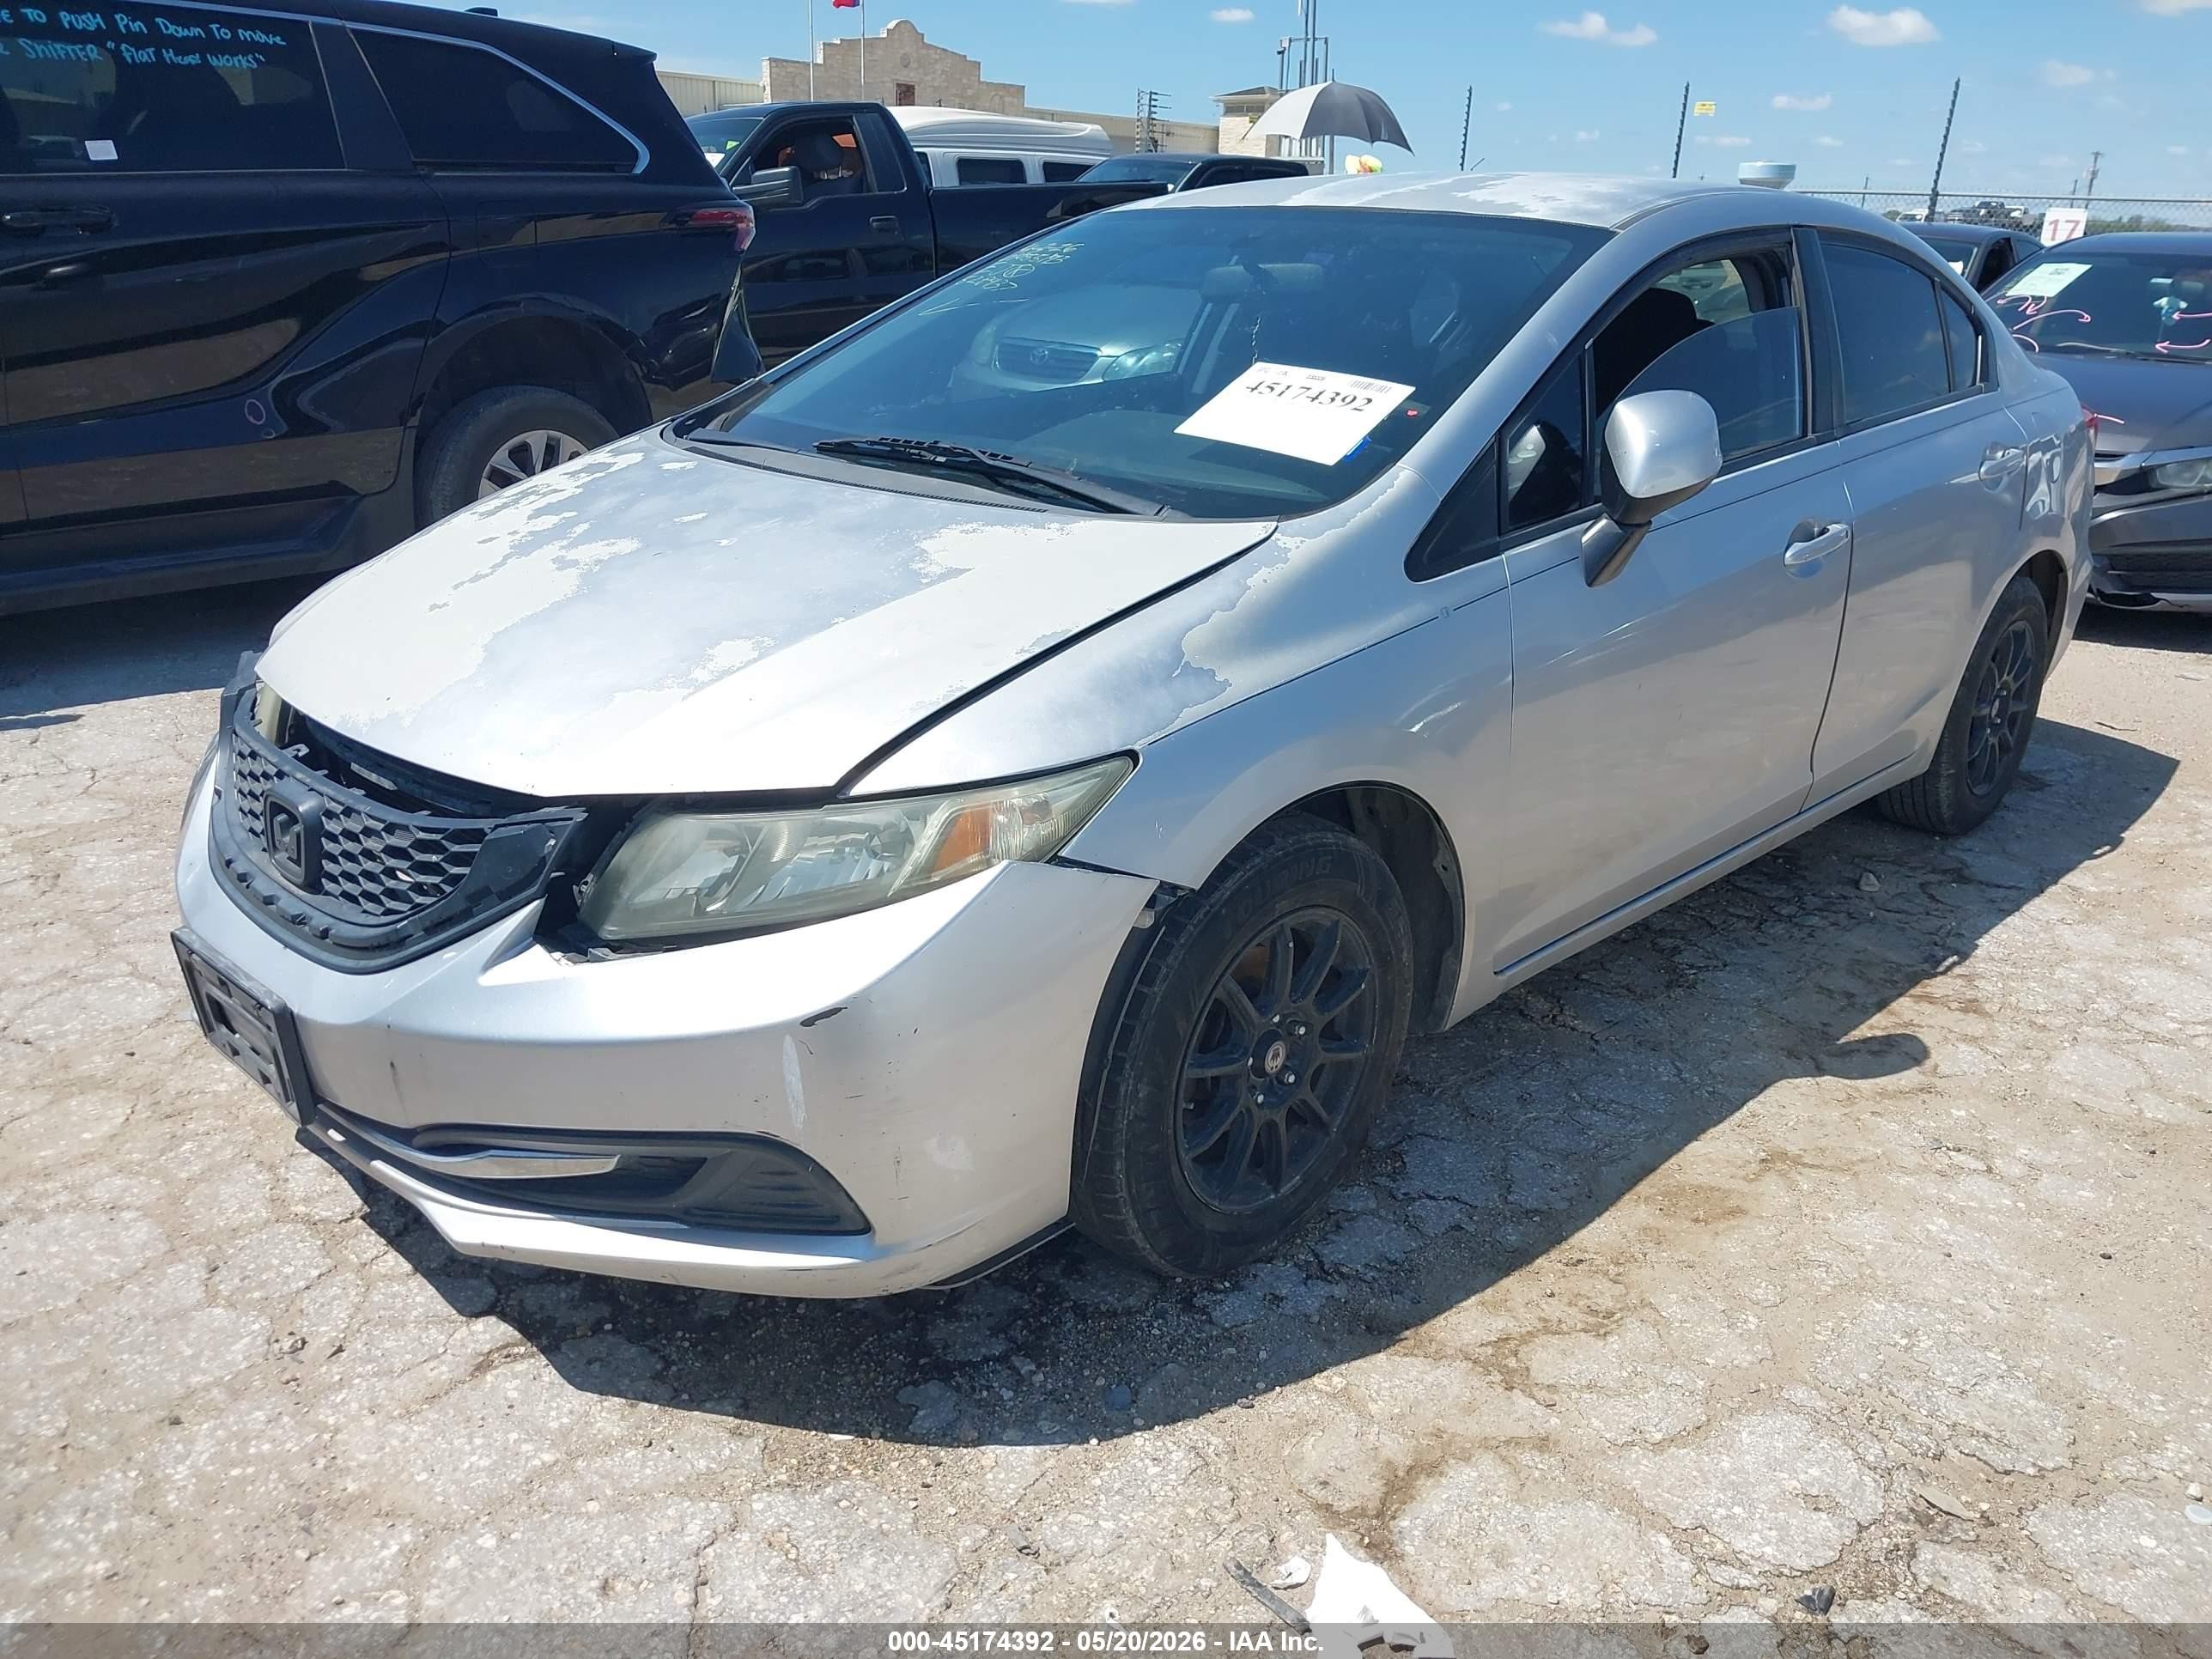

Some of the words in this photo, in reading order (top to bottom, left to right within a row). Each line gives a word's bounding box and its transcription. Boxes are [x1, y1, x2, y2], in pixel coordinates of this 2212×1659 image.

[59, 11, 107, 32] PUSH
[117, 15, 148, 34] Pin
[155, 17, 205, 39] Down
[2047, 219, 2081, 242] 17
[1245, 380, 1373, 412] 45174392
